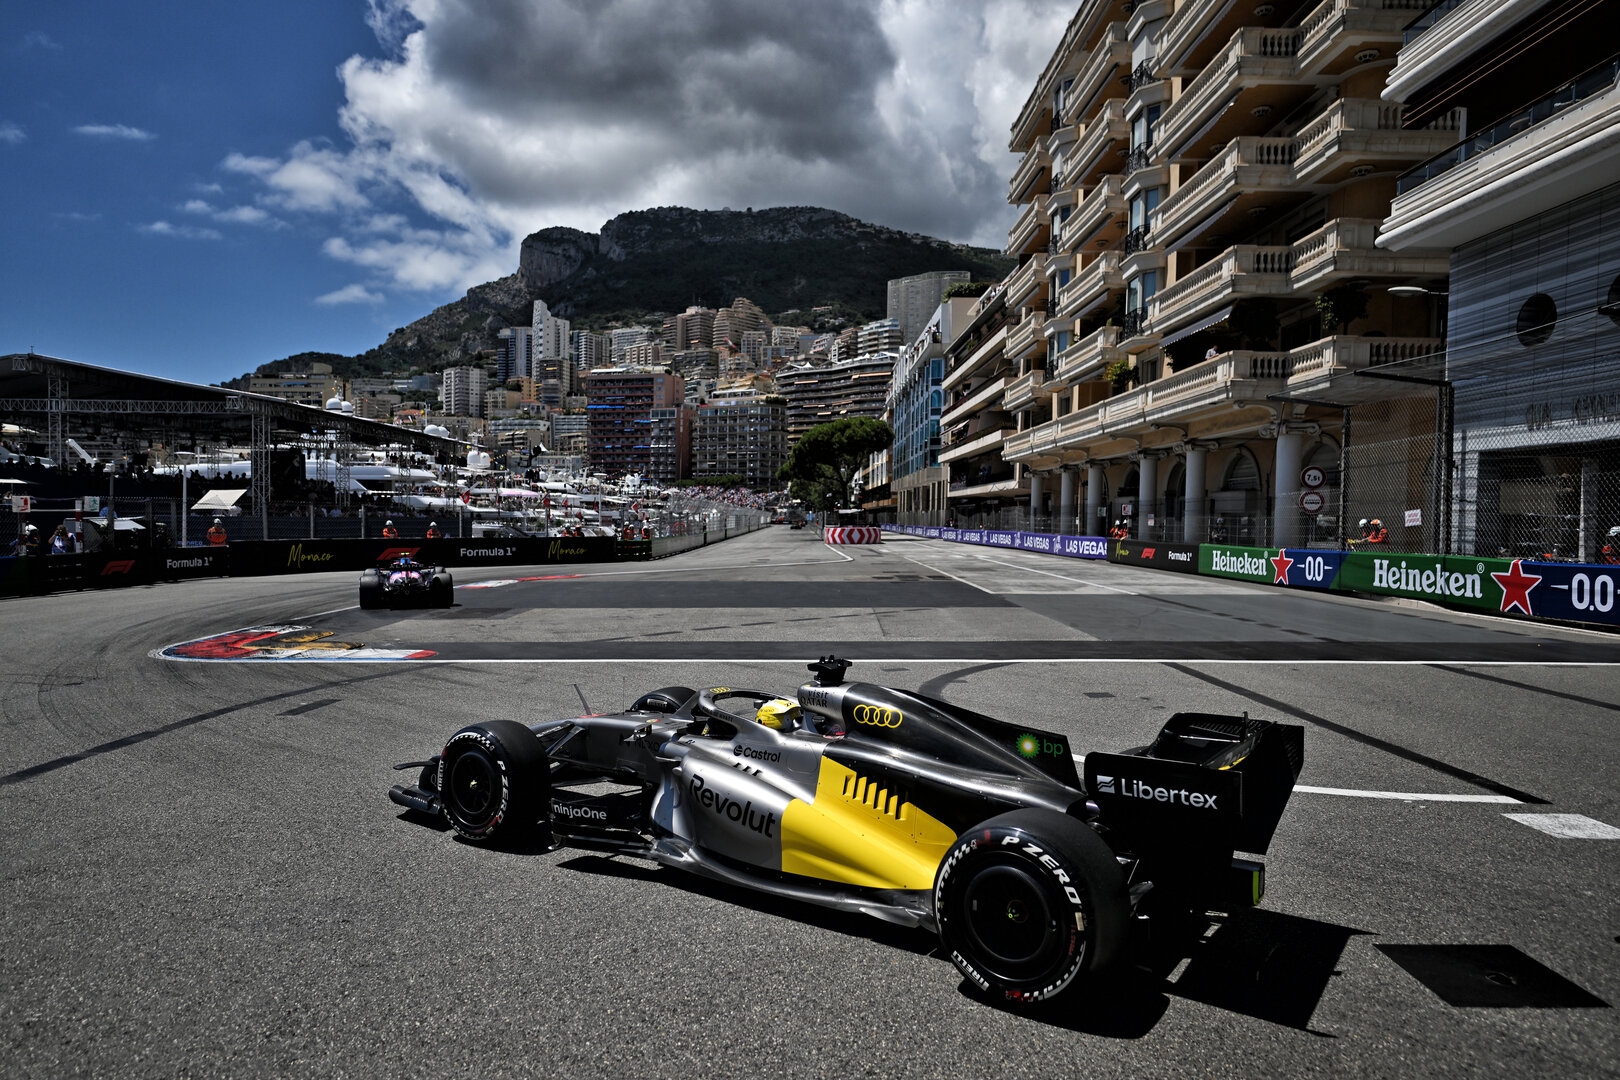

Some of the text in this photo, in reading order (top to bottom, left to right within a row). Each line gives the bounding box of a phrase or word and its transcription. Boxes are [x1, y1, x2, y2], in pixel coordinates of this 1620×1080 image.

[989, 533, 997, 543] LAS
[997, 534, 1011, 545] VEGAS
[1023, 536, 1033, 547] LAS
[1033, 537, 1050, 550] VEGAS
[460, 547, 504, 557] Formula
[547, 539, 588, 560] Monaco
[1065, 540, 1078, 553] LAS
[166, 557, 202, 569] Formula
[287, 543, 334, 569] Monaco
[1168, 551, 1186, 561] Formula
[808, 690, 829, 699] visit
[800, 696, 828, 708] QATAR
[743, 747, 781, 763] Castrol
[1043, 738, 1064, 758] bp
[497, 760, 506, 771] P
[1121, 777, 1218, 810] Libertex
[553, 803, 608, 821] ninjaOne
[689, 773, 776, 839] Revolut
[1000, 835, 1083, 906] P ZERO
